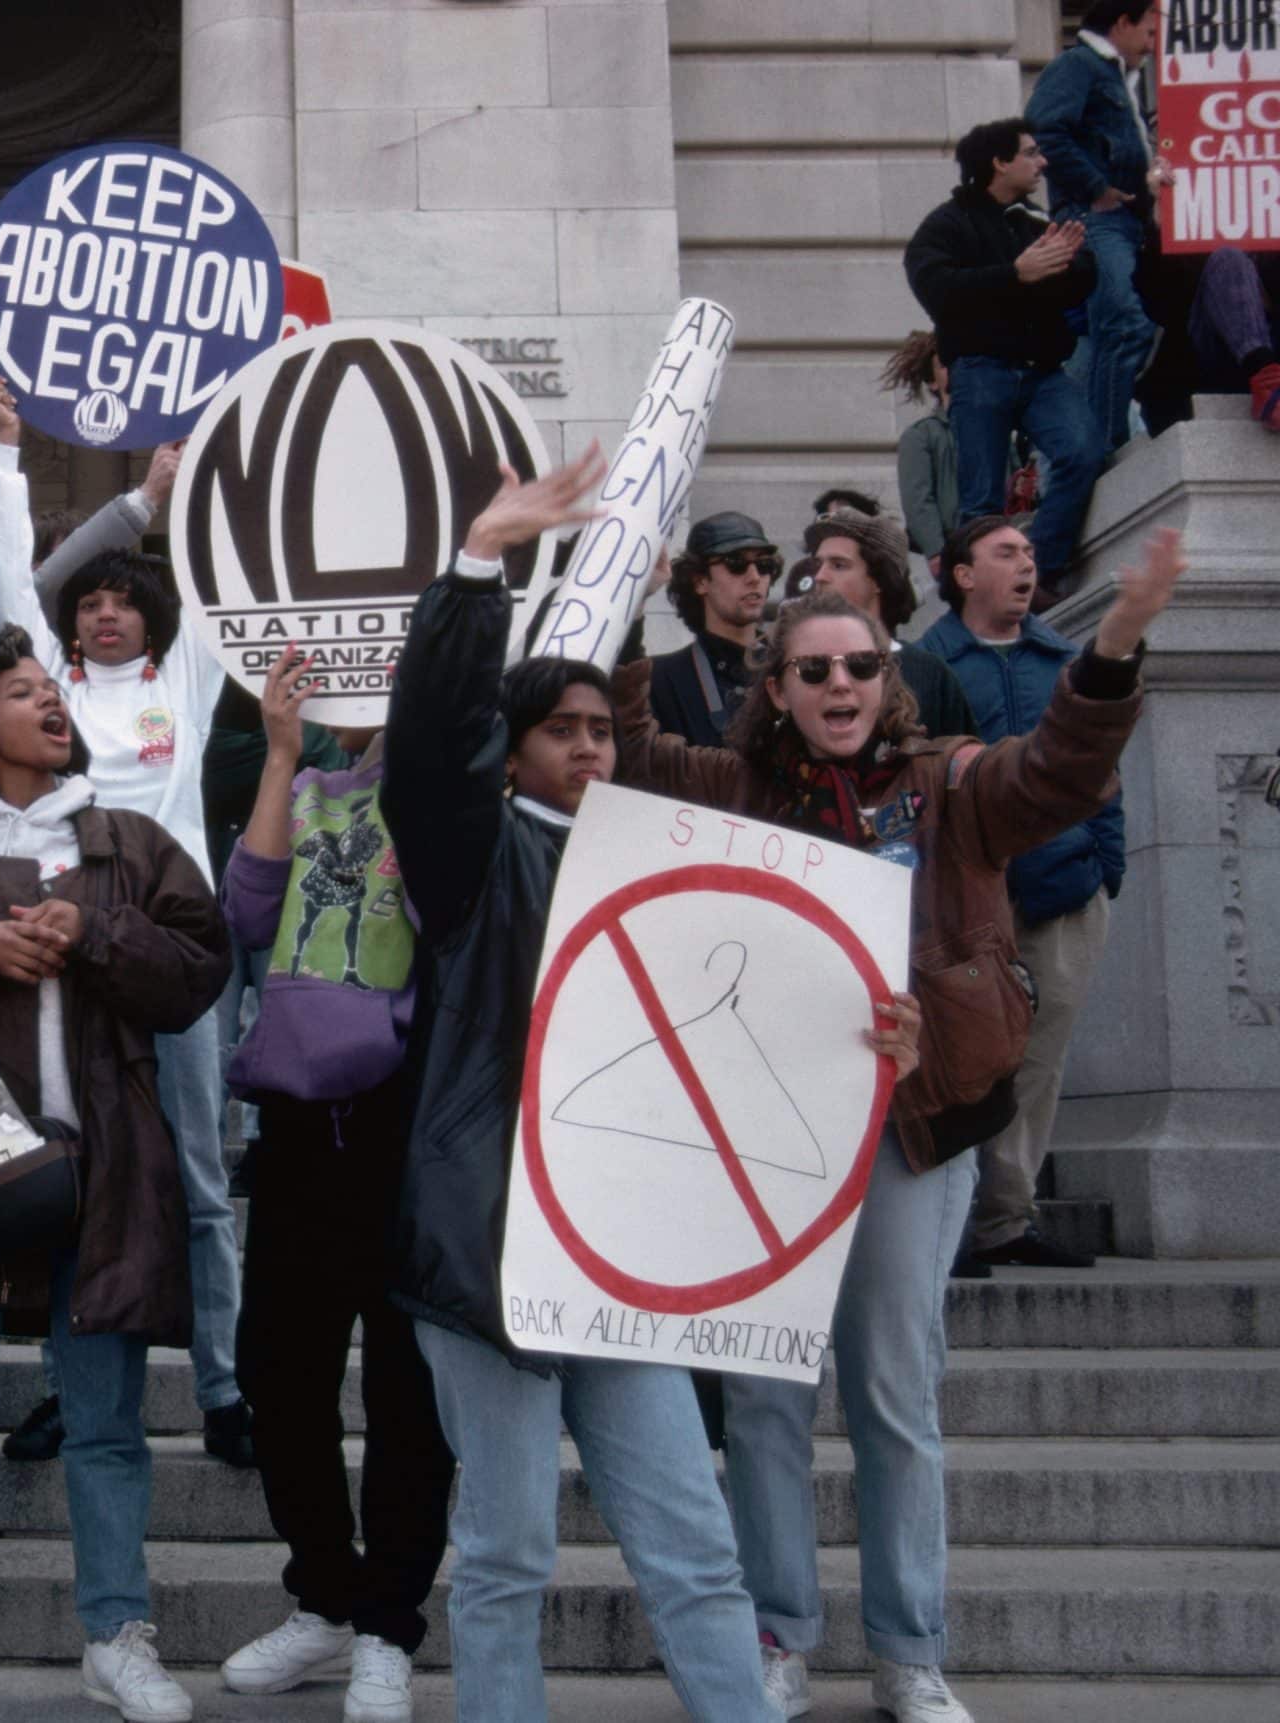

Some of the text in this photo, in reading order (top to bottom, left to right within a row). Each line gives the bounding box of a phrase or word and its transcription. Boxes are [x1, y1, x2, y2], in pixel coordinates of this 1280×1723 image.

[44, 154, 236, 241] KEEP
[668, 808, 825, 880] STOP
[510, 1295, 828, 1368] BACK ALLEY ABORTIONS
